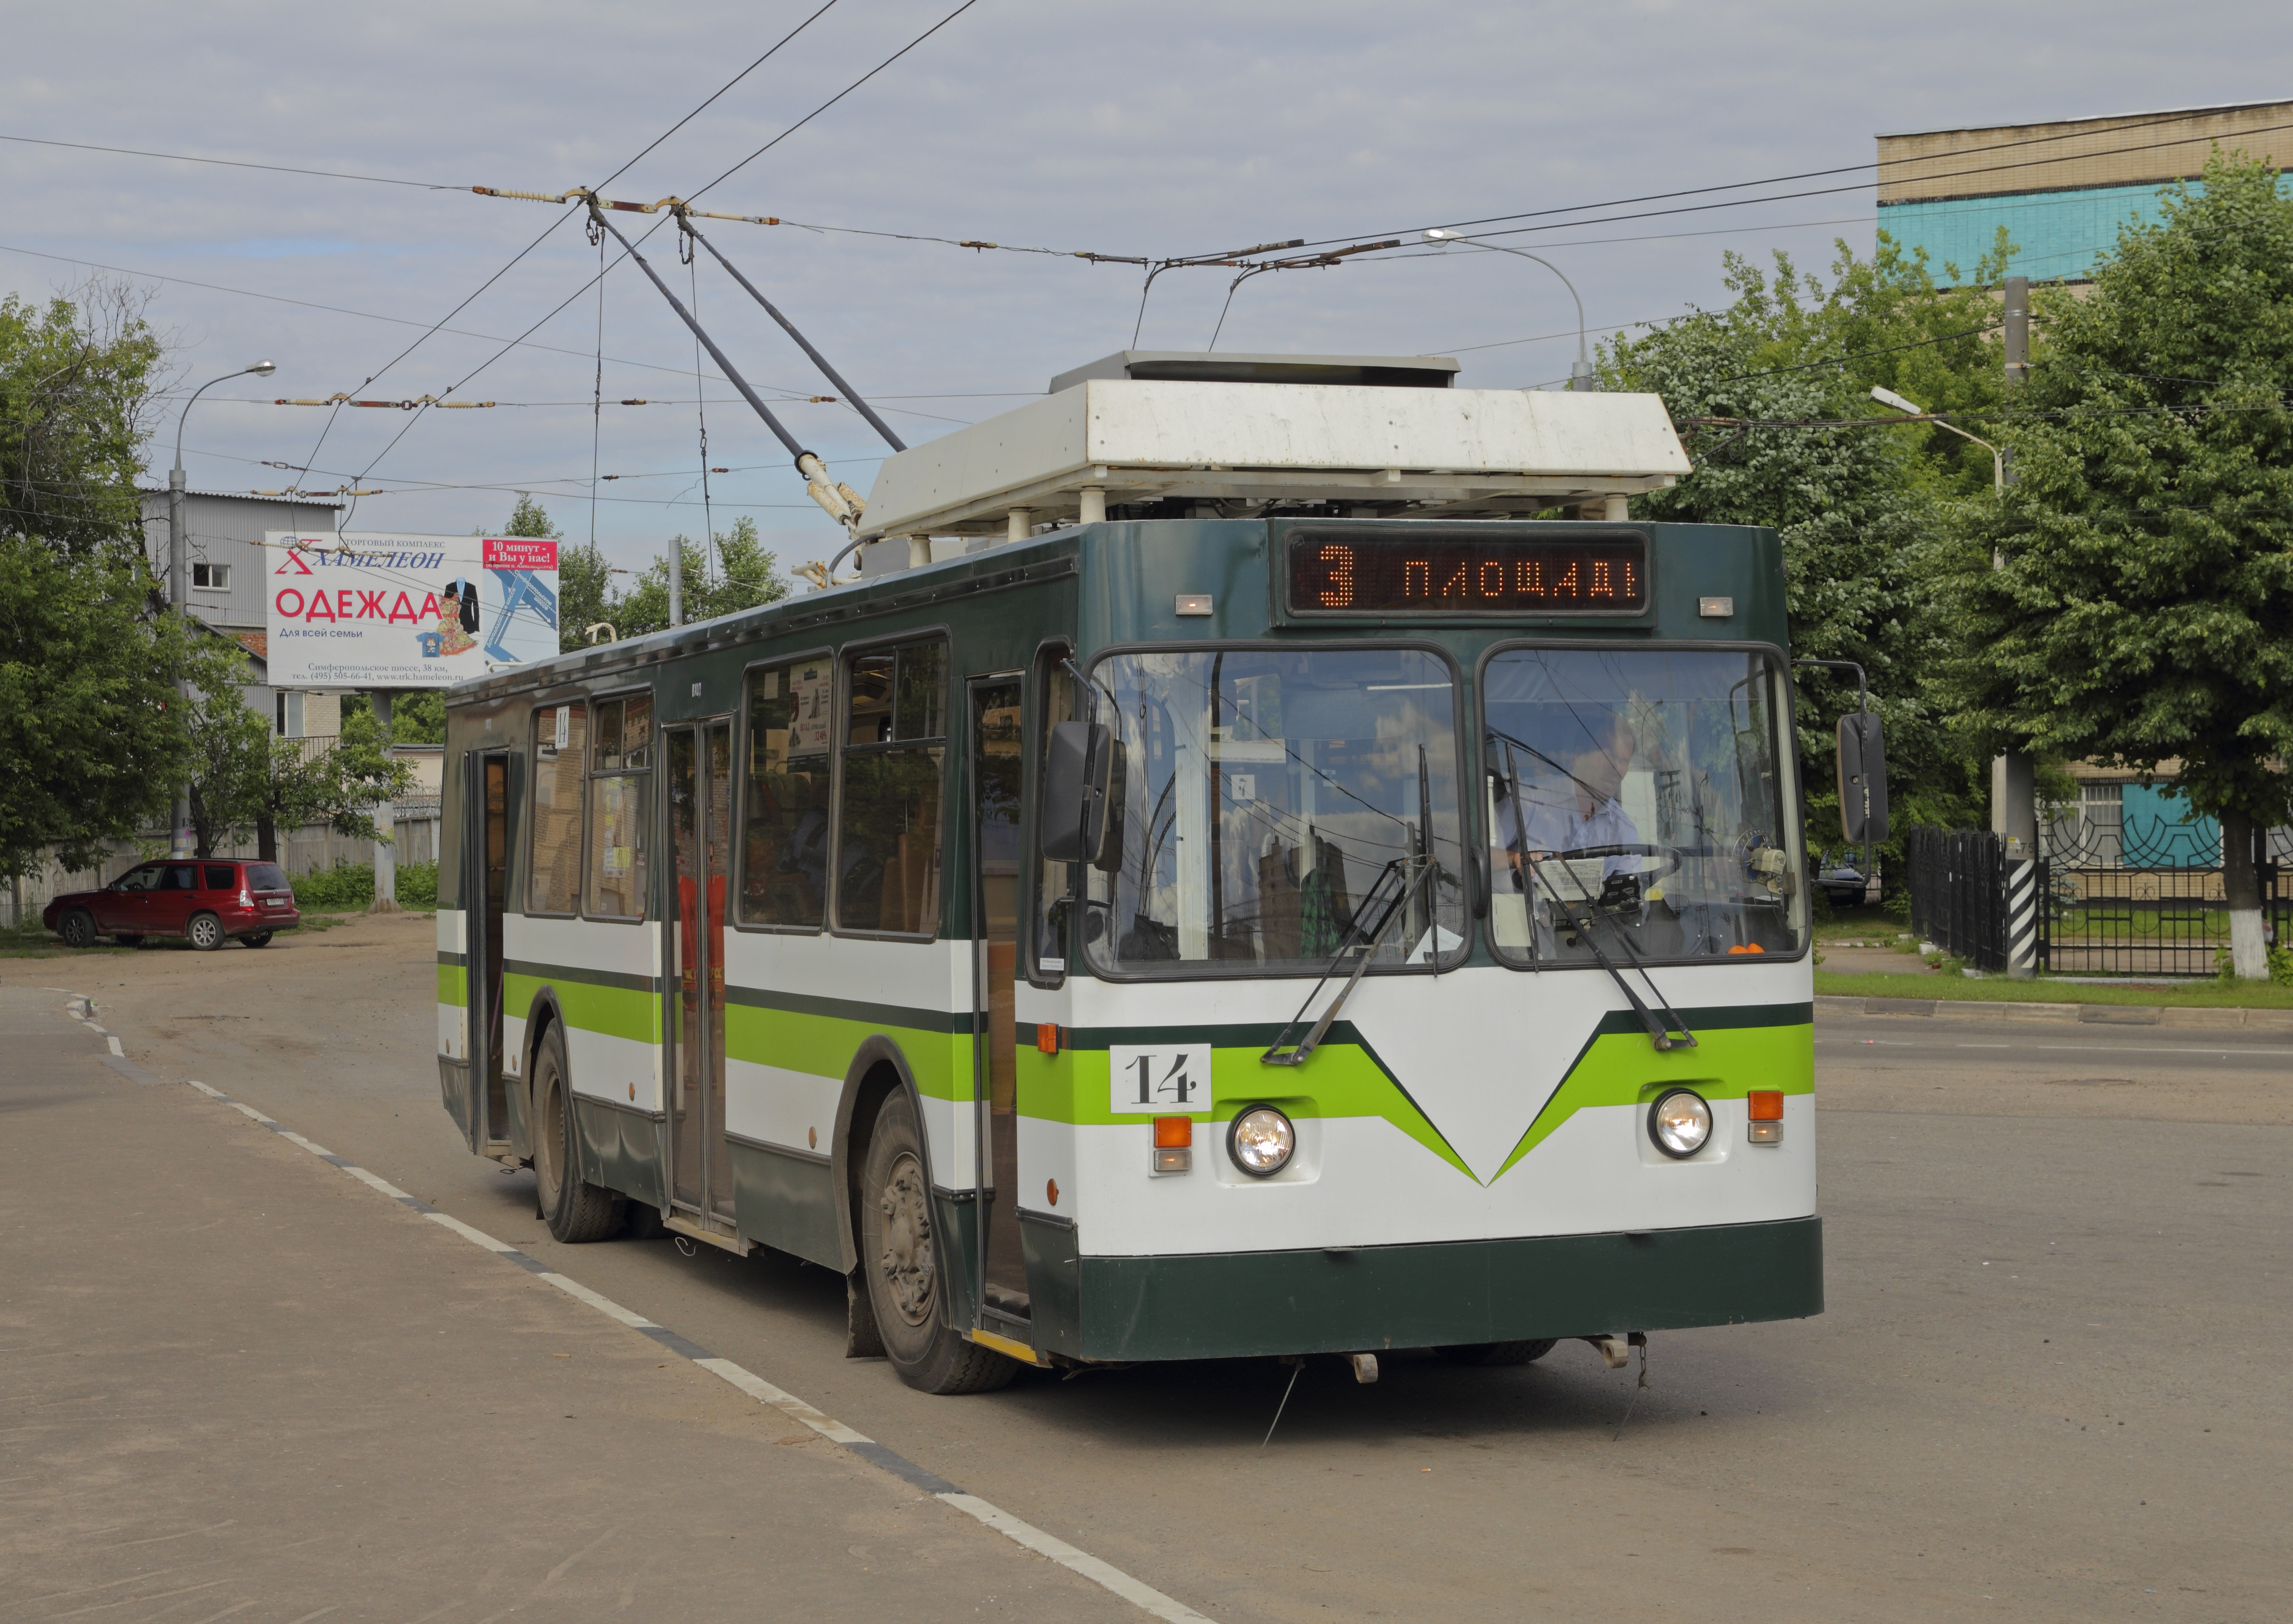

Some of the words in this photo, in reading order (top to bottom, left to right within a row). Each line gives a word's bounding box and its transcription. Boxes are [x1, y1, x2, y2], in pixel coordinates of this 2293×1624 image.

[345, 539, 394, 547] ТОРГОВЫЙ
[493, 541, 503, 551] 10
[506, 545, 539, 555] минут
[311, 550, 446, 569] ХАМЕЛЕОН
[499, 551, 516, 562] Вы
[520, 555, 526, 564] у
[528, 553, 550, 562] нас!
[1320, 546, 1352, 606] 3
[276, 589, 443, 625] ОДЕЖДА
[280, 628, 300, 638] Для
[303, 629, 327, 637] всей
[330, 630, 362, 638] семьи
[308, 663, 389, 674] Симферопольское
[311, 672, 331, 681] (495)
[334, 672, 374, 681] 505-66-41,
[558, 712, 567, 743] 14
[1125, 1053, 1197, 1105] 14
